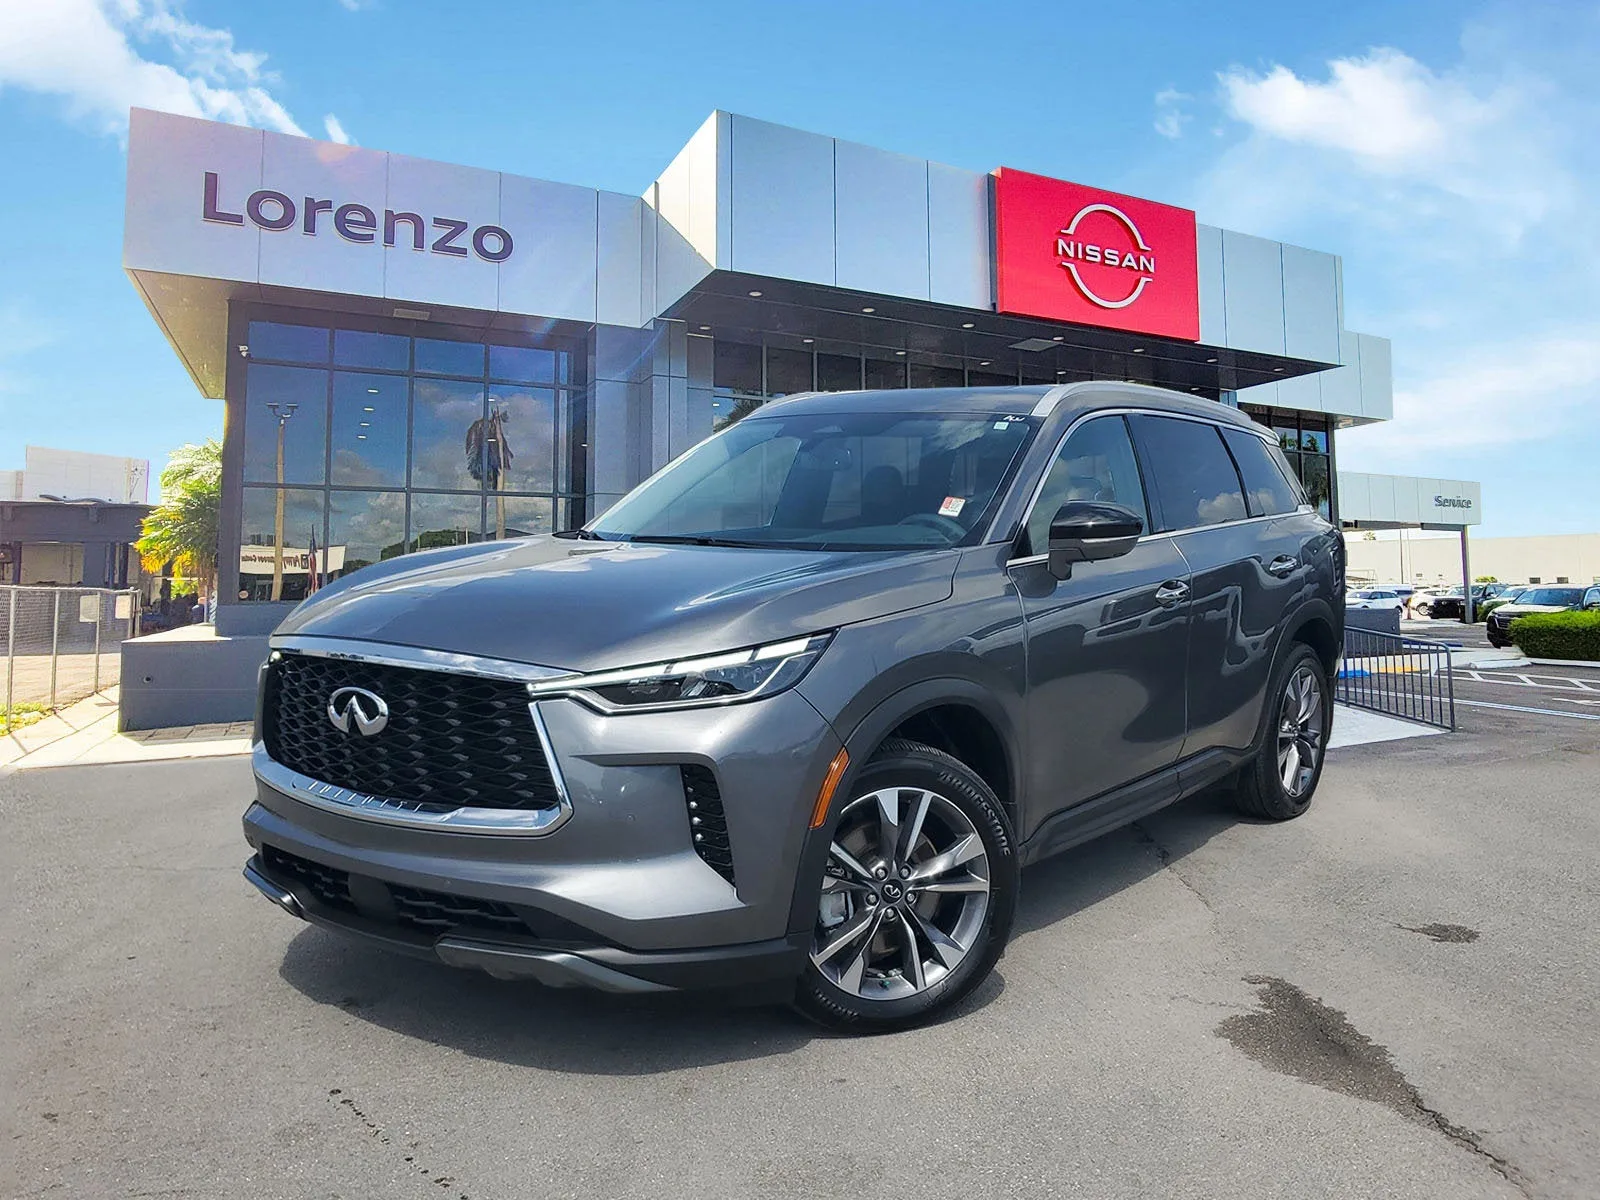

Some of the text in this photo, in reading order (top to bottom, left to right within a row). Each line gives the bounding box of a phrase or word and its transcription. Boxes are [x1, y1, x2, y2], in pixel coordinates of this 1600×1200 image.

[202, 170, 515, 263] Lorenzo
[1057, 238, 1155, 274] NISSAN
[1434, 495, 1472, 509] Service
[308, 780, 423, 813] INFINITI
